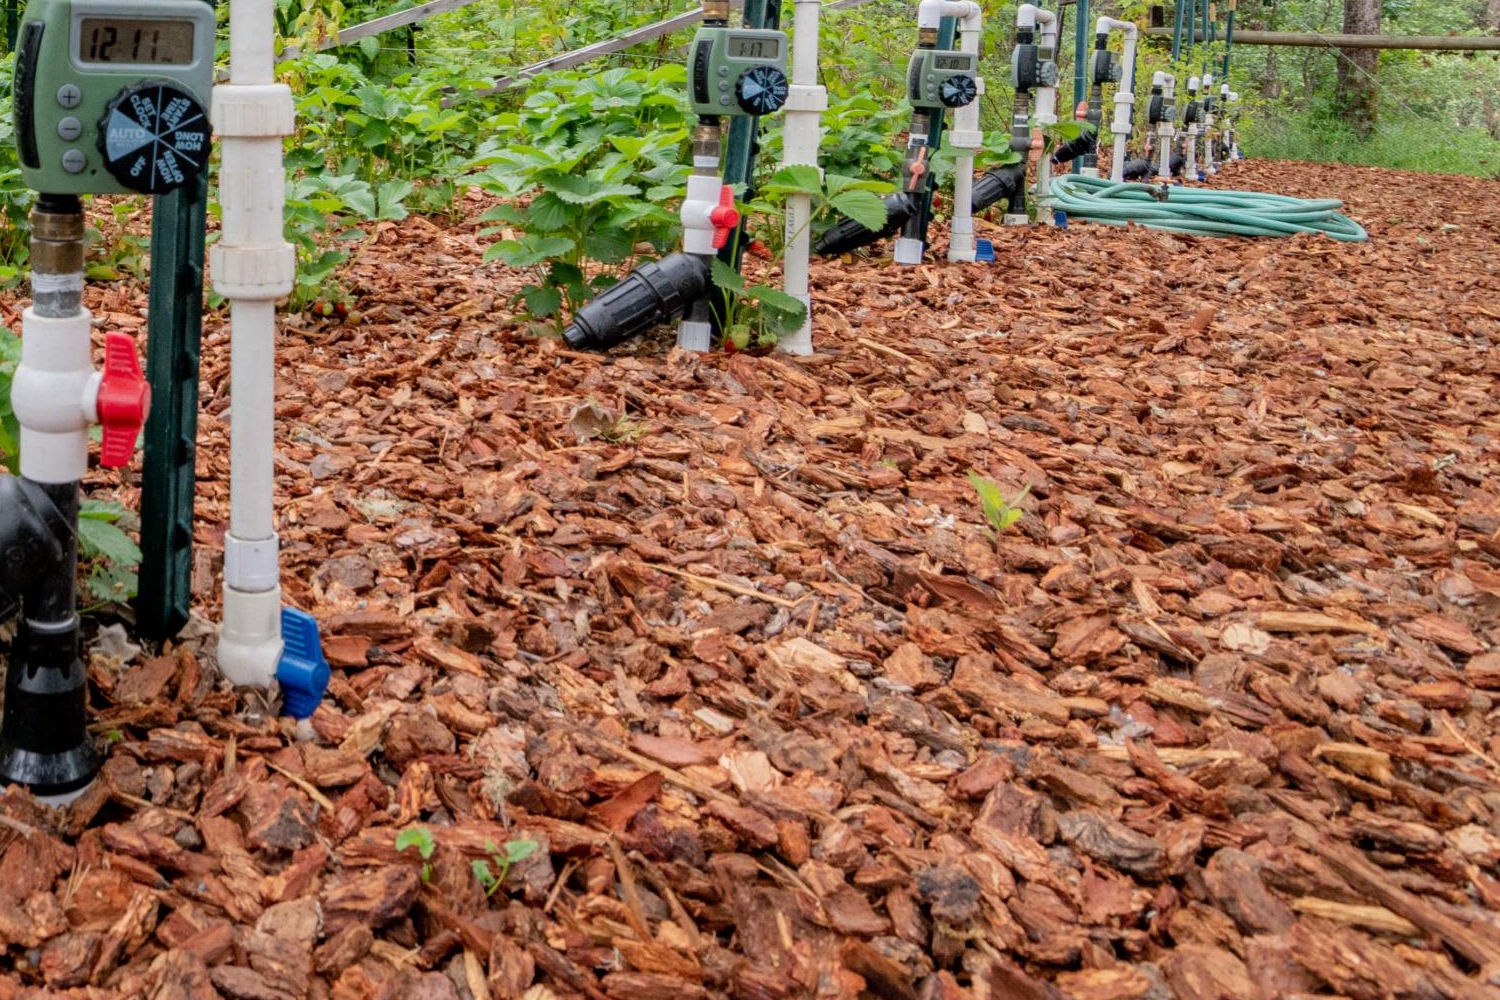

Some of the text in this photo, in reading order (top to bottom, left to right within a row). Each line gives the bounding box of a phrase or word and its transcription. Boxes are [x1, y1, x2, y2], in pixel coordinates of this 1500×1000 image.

[130, 94, 152, 130] CLOCK
[141, 97, 157, 117] SET
[160, 97, 181, 122] TIME
[166, 98, 192, 131] START
[109, 128, 146, 139] AUTO
[175, 131, 204, 142] LONG
[175, 142, 202, 151] HOW
[130, 156, 147, 177] OFF
[156, 159, 174, 184] HOW
[163, 150, 184, 183] OFTEN
